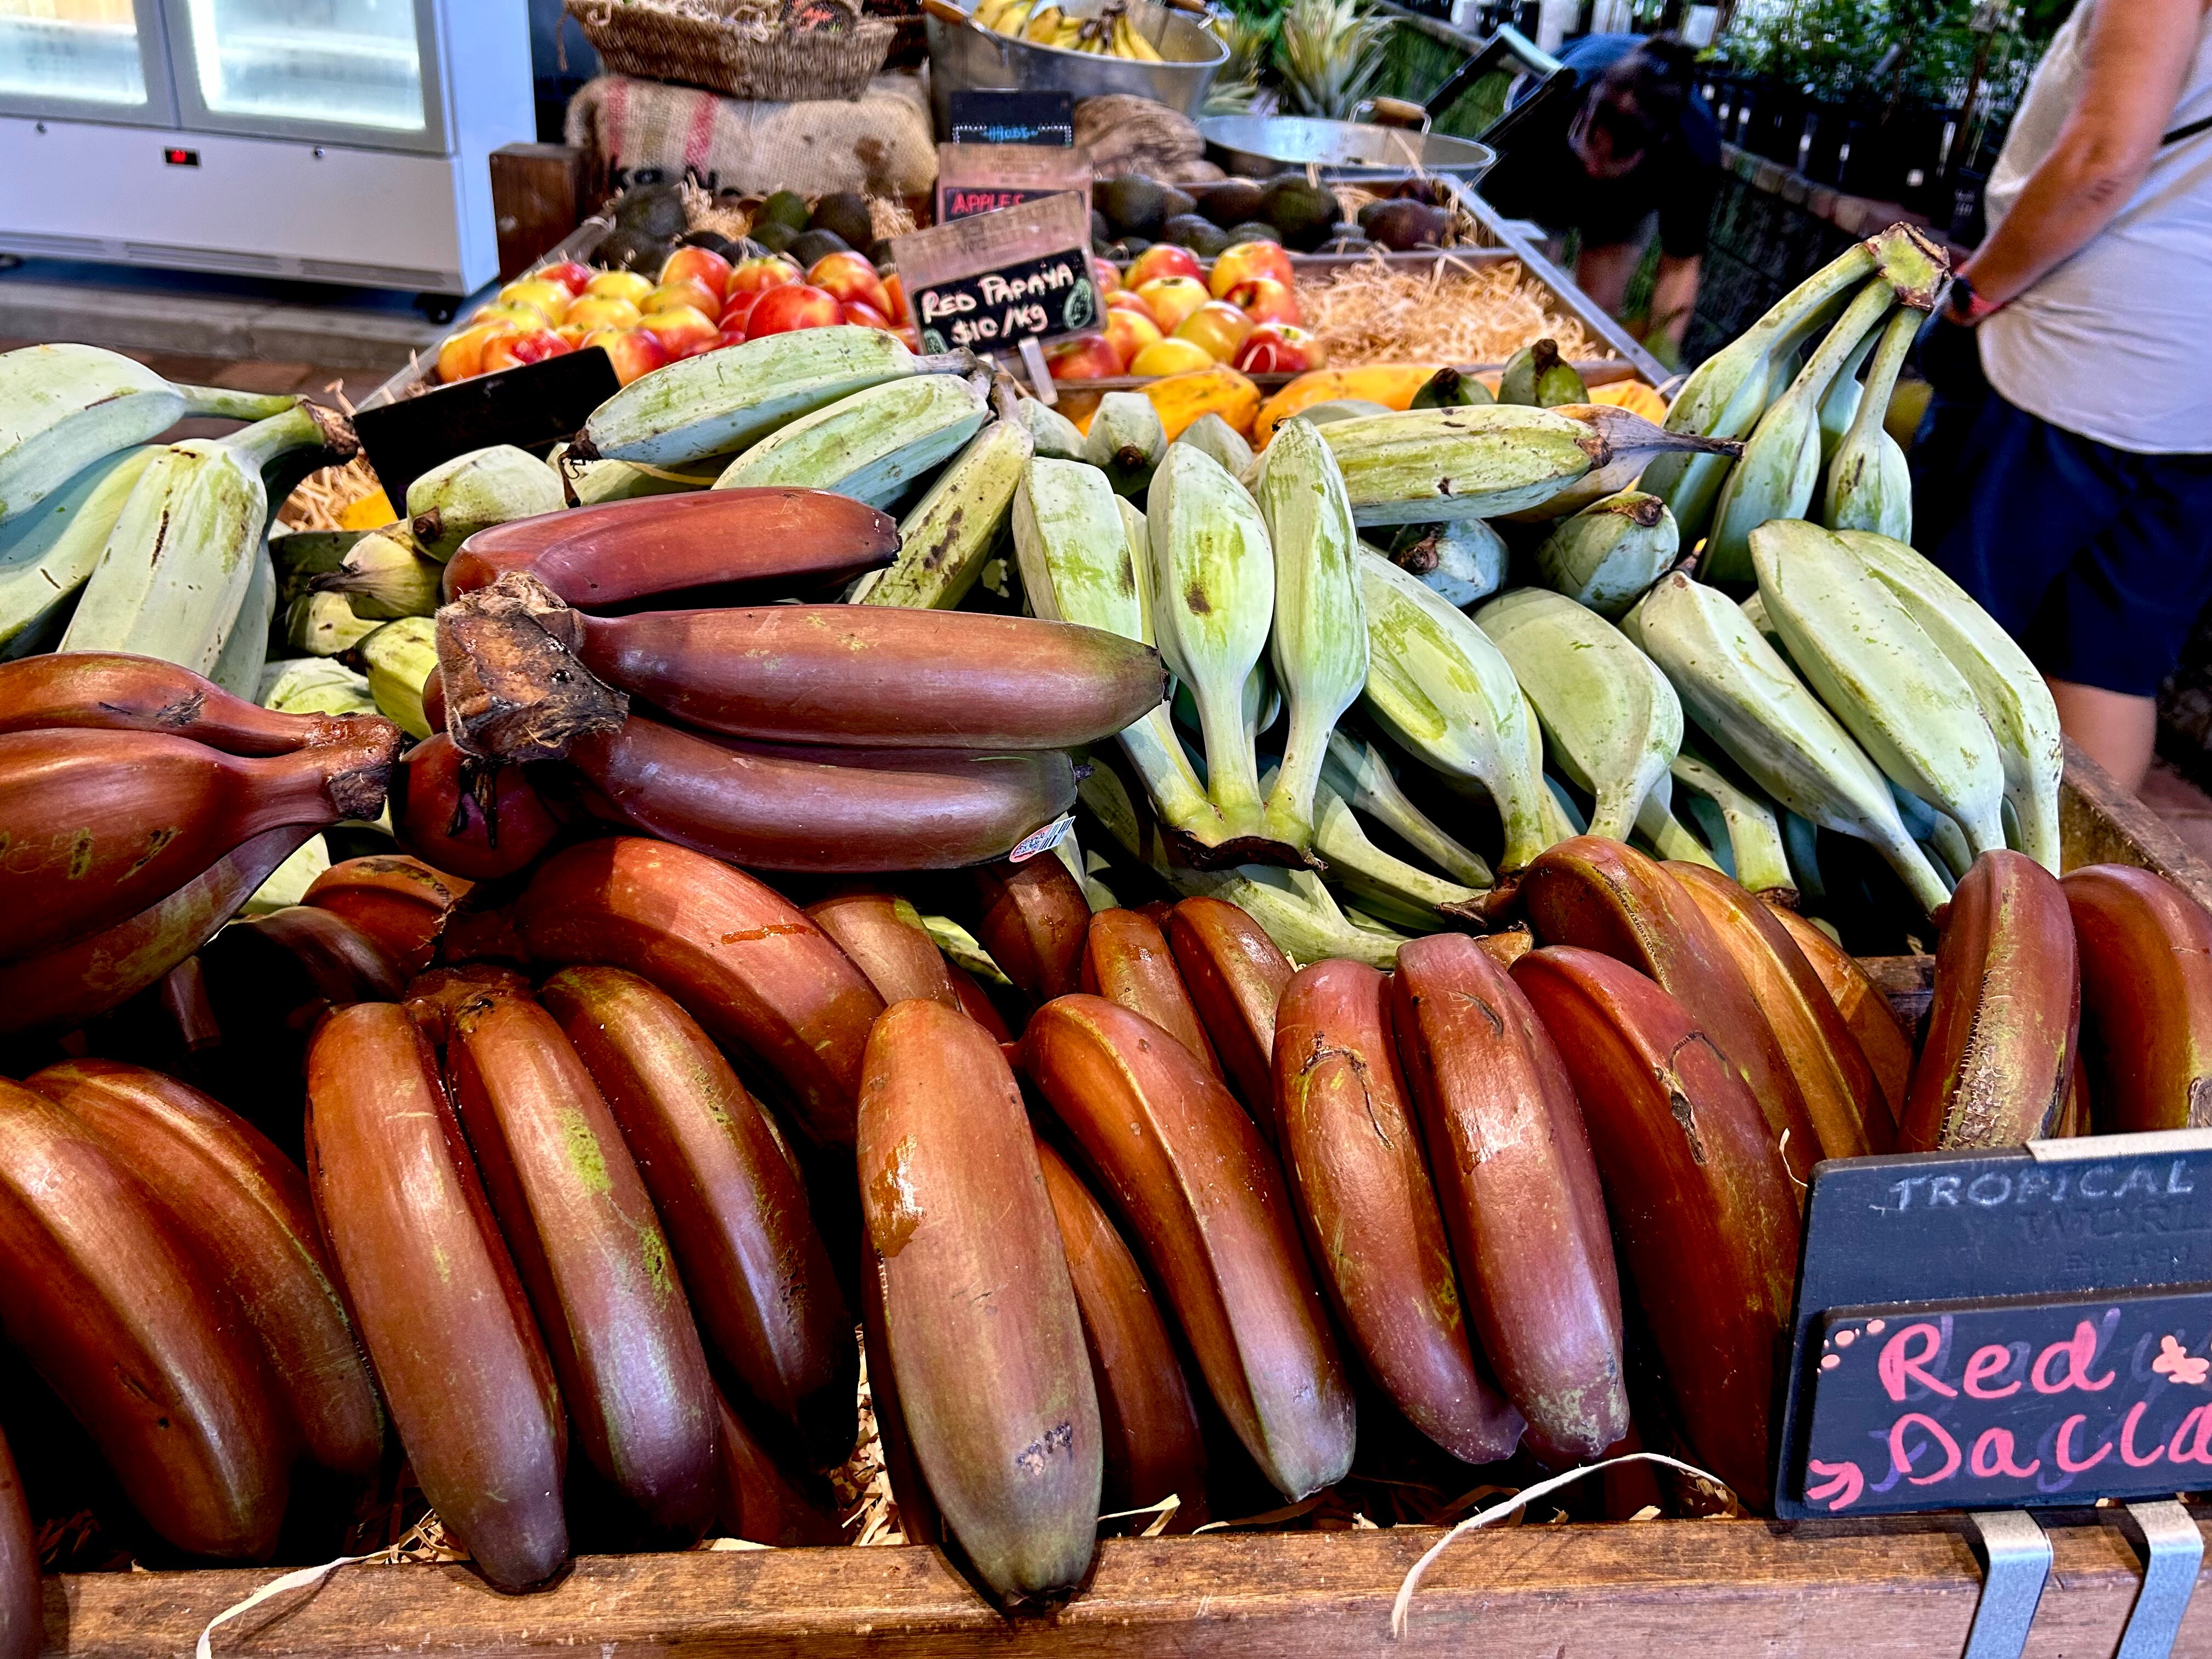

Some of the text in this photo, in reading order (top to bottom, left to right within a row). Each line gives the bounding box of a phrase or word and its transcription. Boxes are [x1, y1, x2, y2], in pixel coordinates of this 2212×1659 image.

[922, 263, 1074, 324] RED PAPAYA
[1889, 1160, 2194, 1212] TROPICAL
[1878, 1320, 2115, 1401] Red
